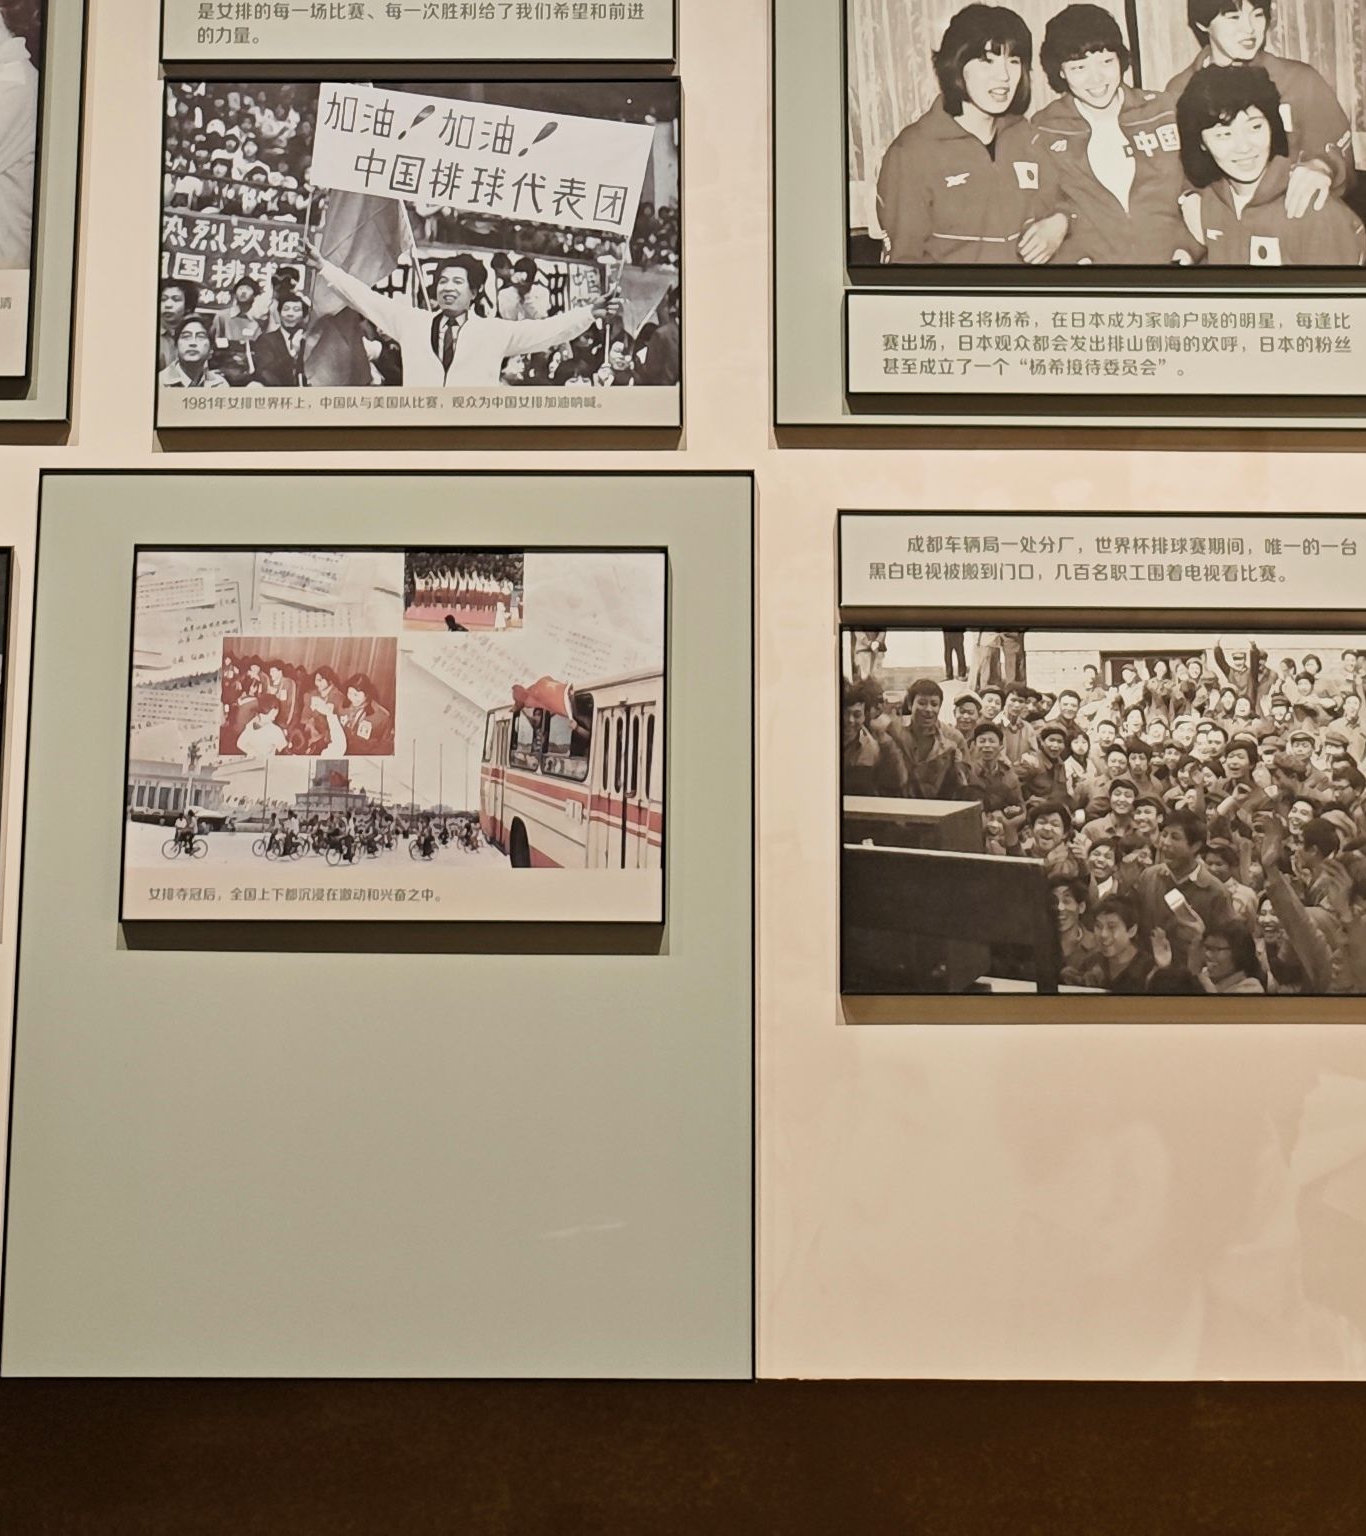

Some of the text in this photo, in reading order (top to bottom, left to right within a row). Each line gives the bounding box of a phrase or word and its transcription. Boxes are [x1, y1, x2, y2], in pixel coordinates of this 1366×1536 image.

[198, 2, 644, 20] 是女排的每一场比赛、每一次胜利给了我们希望和前进
[197, 26, 259, 44] 的力量。
[324, 91, 559, 157] 加油！加油！
[1133, 123, 1181, 158] 中国
[352, 149, 629, 227] 中国排球代表团
[920, 310, 1351, 329] 女排名将杨希，在日本成为家喻户晓的明星，每逢比
[882, 334, 1351, 353] 赛出场，日本观众都会发出排山倒海的欢呼，日本的粉丝
[907, 535, 1356, 556] 成都车辆局一处分厂，世界杯排球赛期间，唯一的一台
[869, 562, 1285, 582] 黑白电视被搬到门口，几百名职工围着电视看比赛。
[148, 888, 440, 902] 女排夺冠后，全国上下都沉浸在激动和兴奋之中。
